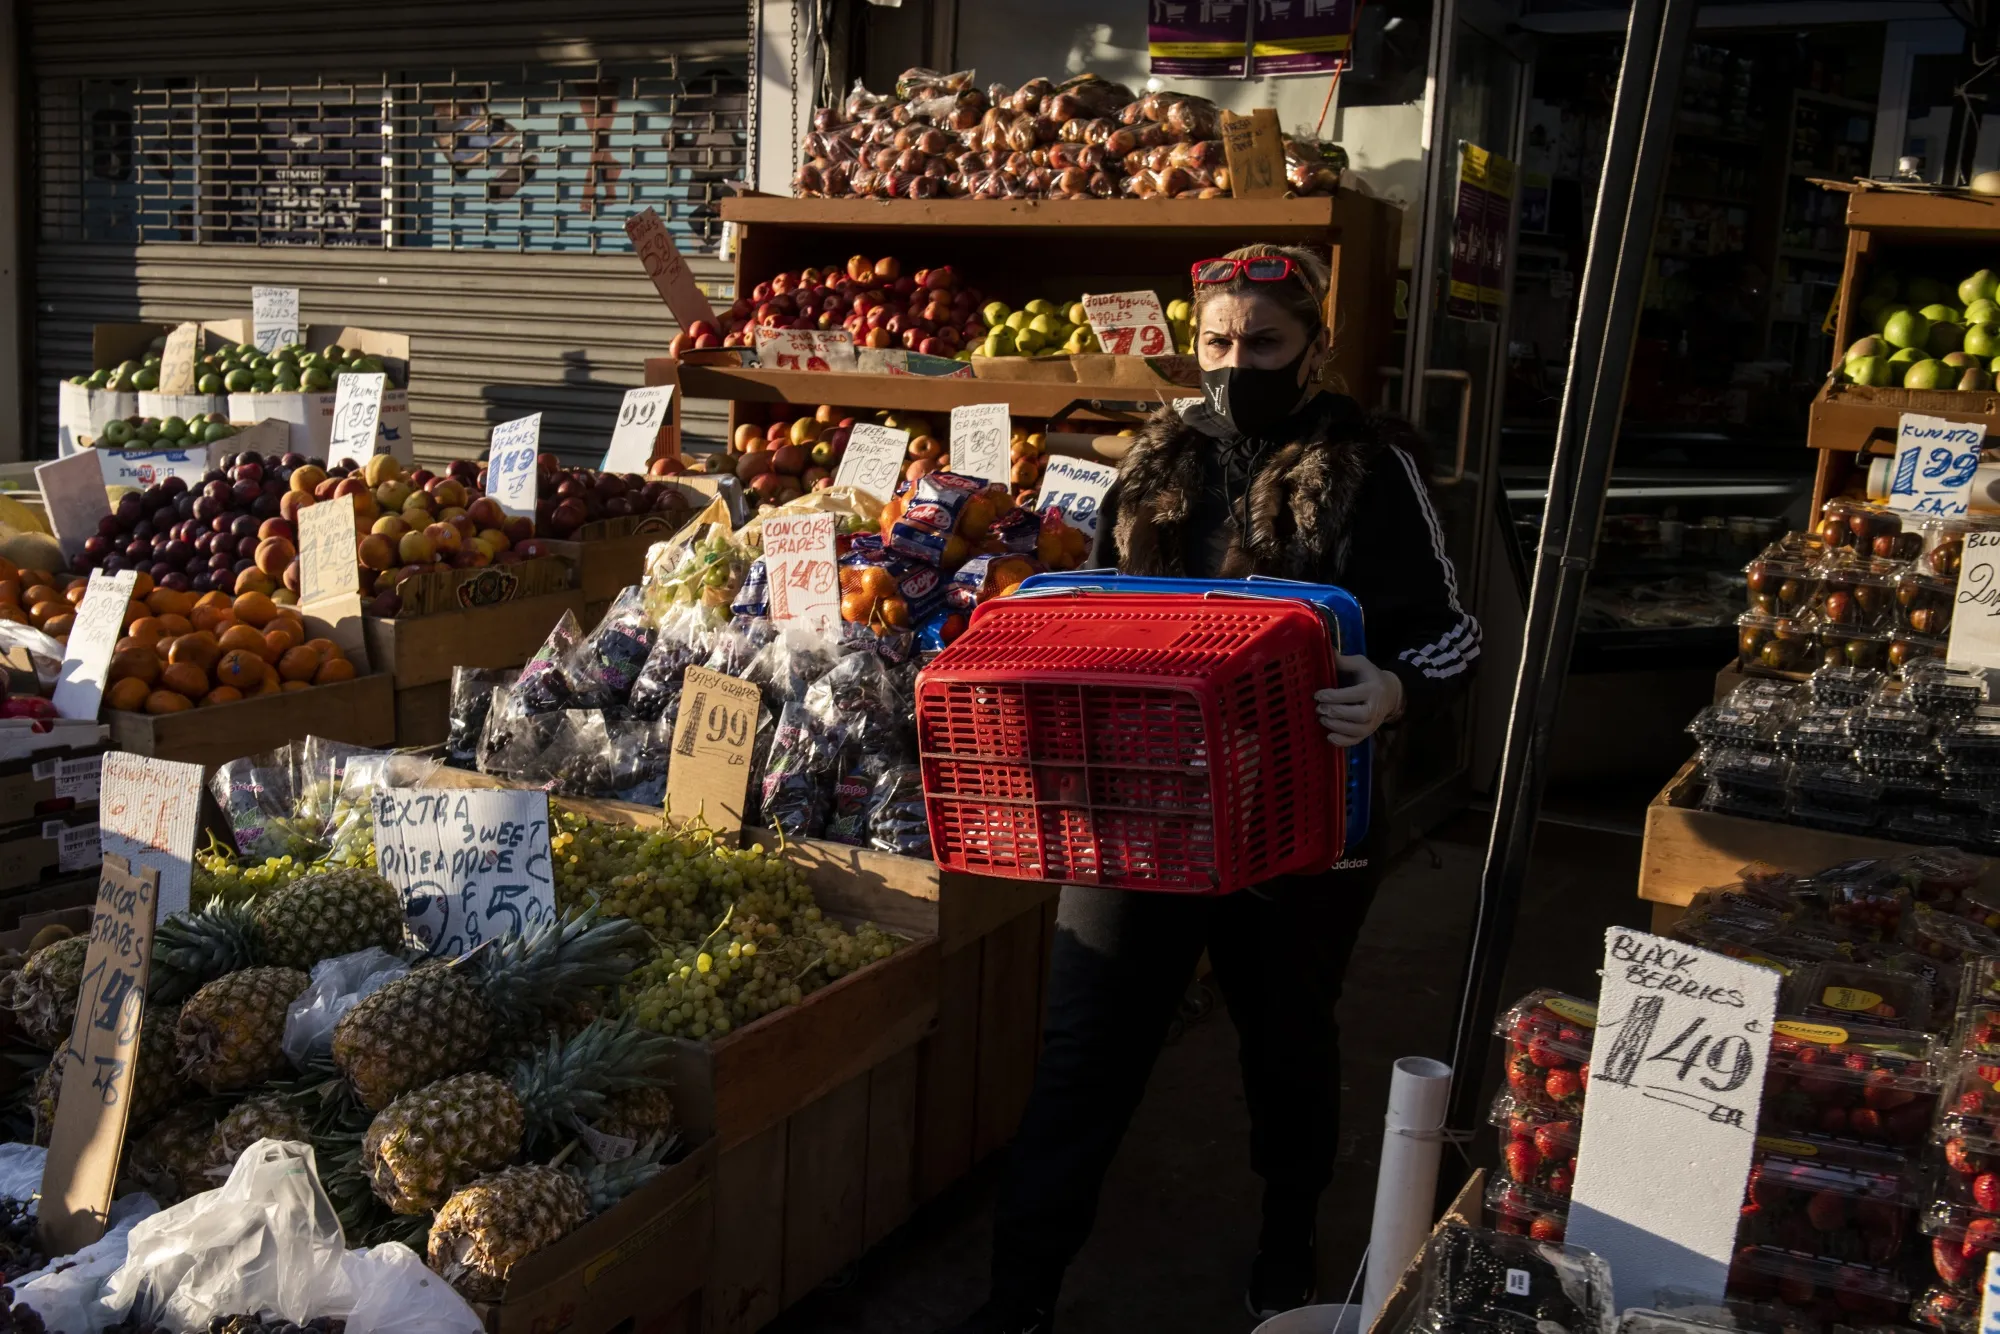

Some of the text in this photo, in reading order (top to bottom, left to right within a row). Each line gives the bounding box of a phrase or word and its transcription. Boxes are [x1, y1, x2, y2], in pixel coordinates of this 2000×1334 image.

[241, 187, 361, 208] MEDICAL
[256, 327, 299, 352] 79
[1100, 325, 1165, 355] 79
[495, 418, 528, 435] SWEET
[853, 424, 888, 437] GREEN
[1901, 423, 1979, 444] KUMATO
[493, 431, 536, 451] PEACHES
[848, 442, 892, 459] GRAPES
[120, 467, 175, 479] BIG APPLE
[1046, 462, 1113, 488] MANDARIN
[1913, 498, 1968, 516] EACH
[766, 535, 827, 557] GRAPES
[686, 667, 763, 702] BABY GRAPES
[727, 753, 745, 765] LB
[379, 793, 470, 828] EXTRA
[462, 820, 546, 849] SWEET
[1331, 858, 1368, 870] adidas
[91, 912, 143, 968] GRAPES
[1611, 934, 1698, 974] BLACK
[1625, 965, 1745, 1008] BERRIES
